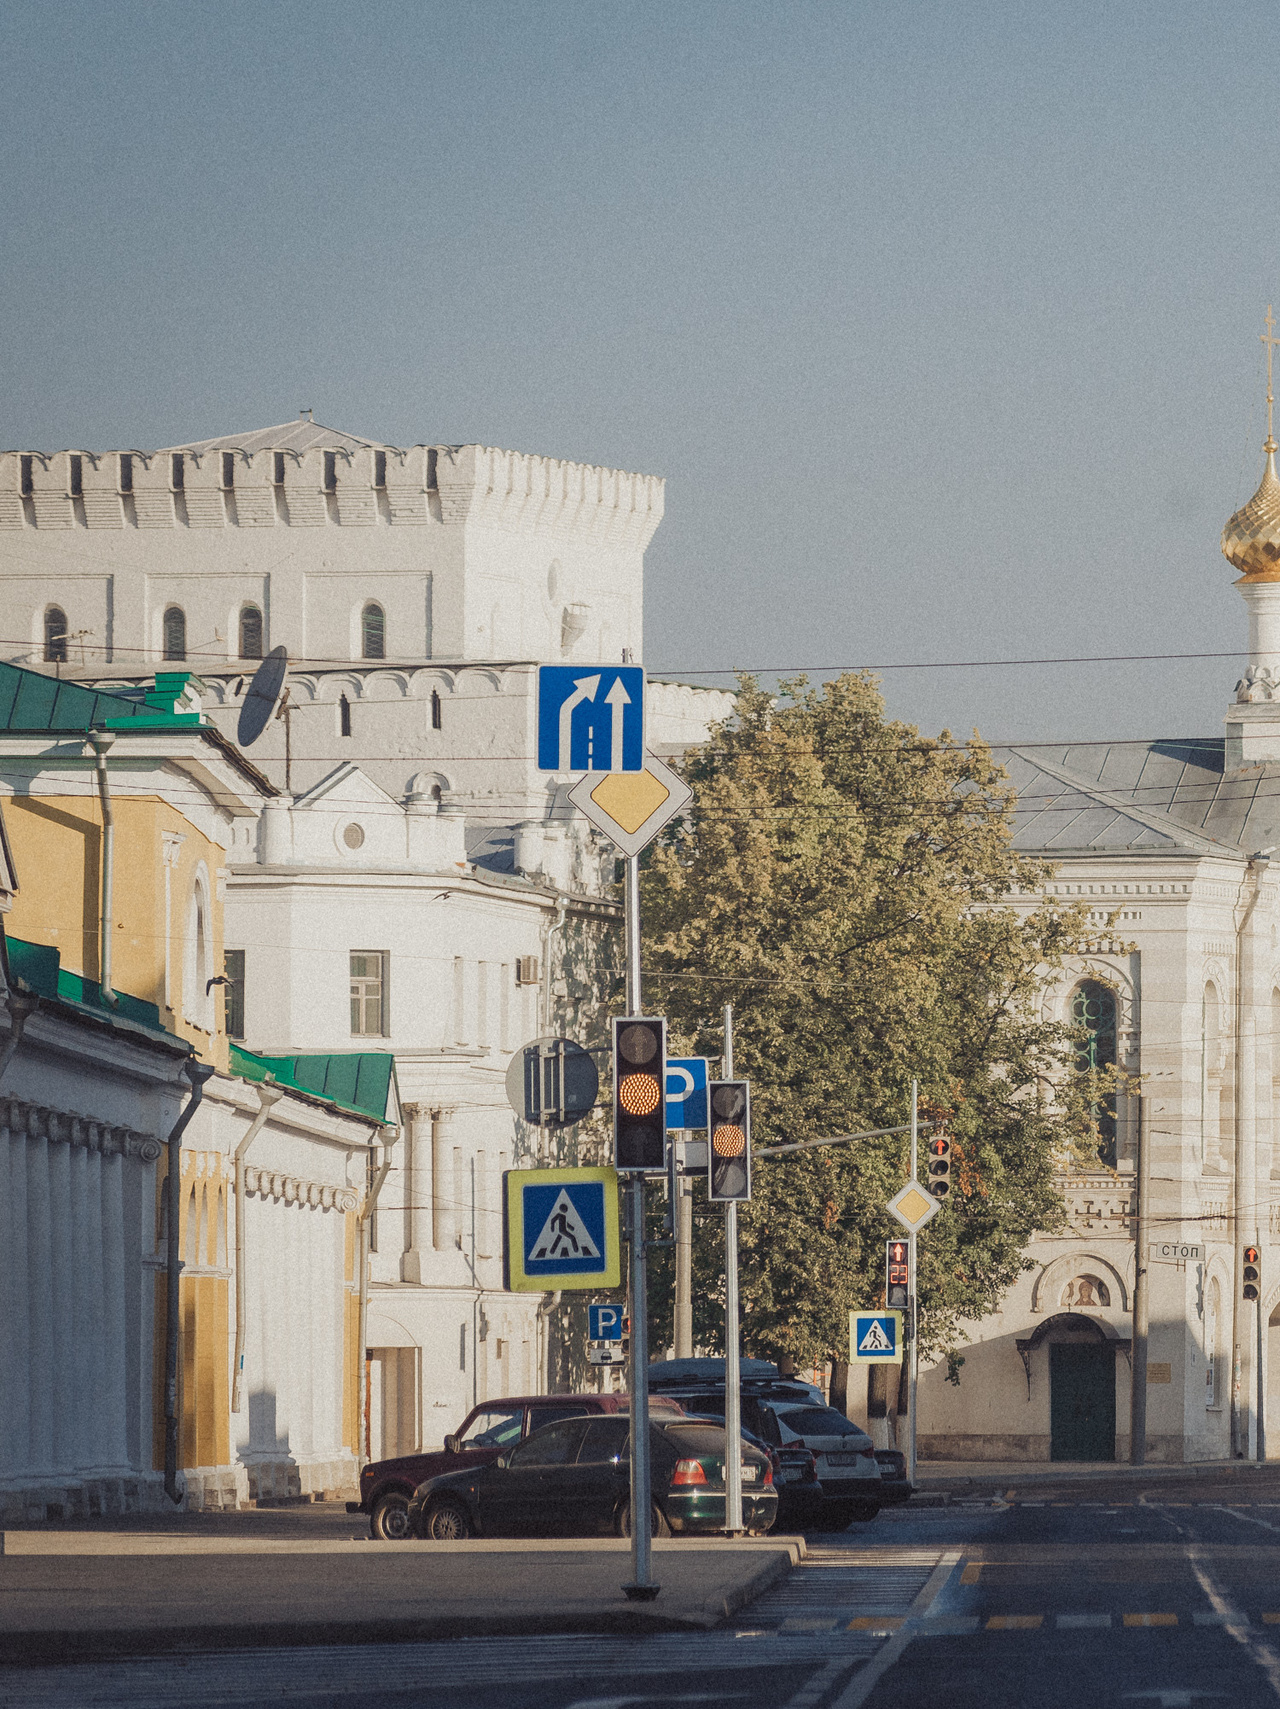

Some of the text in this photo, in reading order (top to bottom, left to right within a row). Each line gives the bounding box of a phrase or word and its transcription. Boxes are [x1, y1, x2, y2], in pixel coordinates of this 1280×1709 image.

[1161, 1244, 1199, 1258] СТОП
[890, 1264, 908, 1284] 23
[598, 1308, 617, 1337] P
